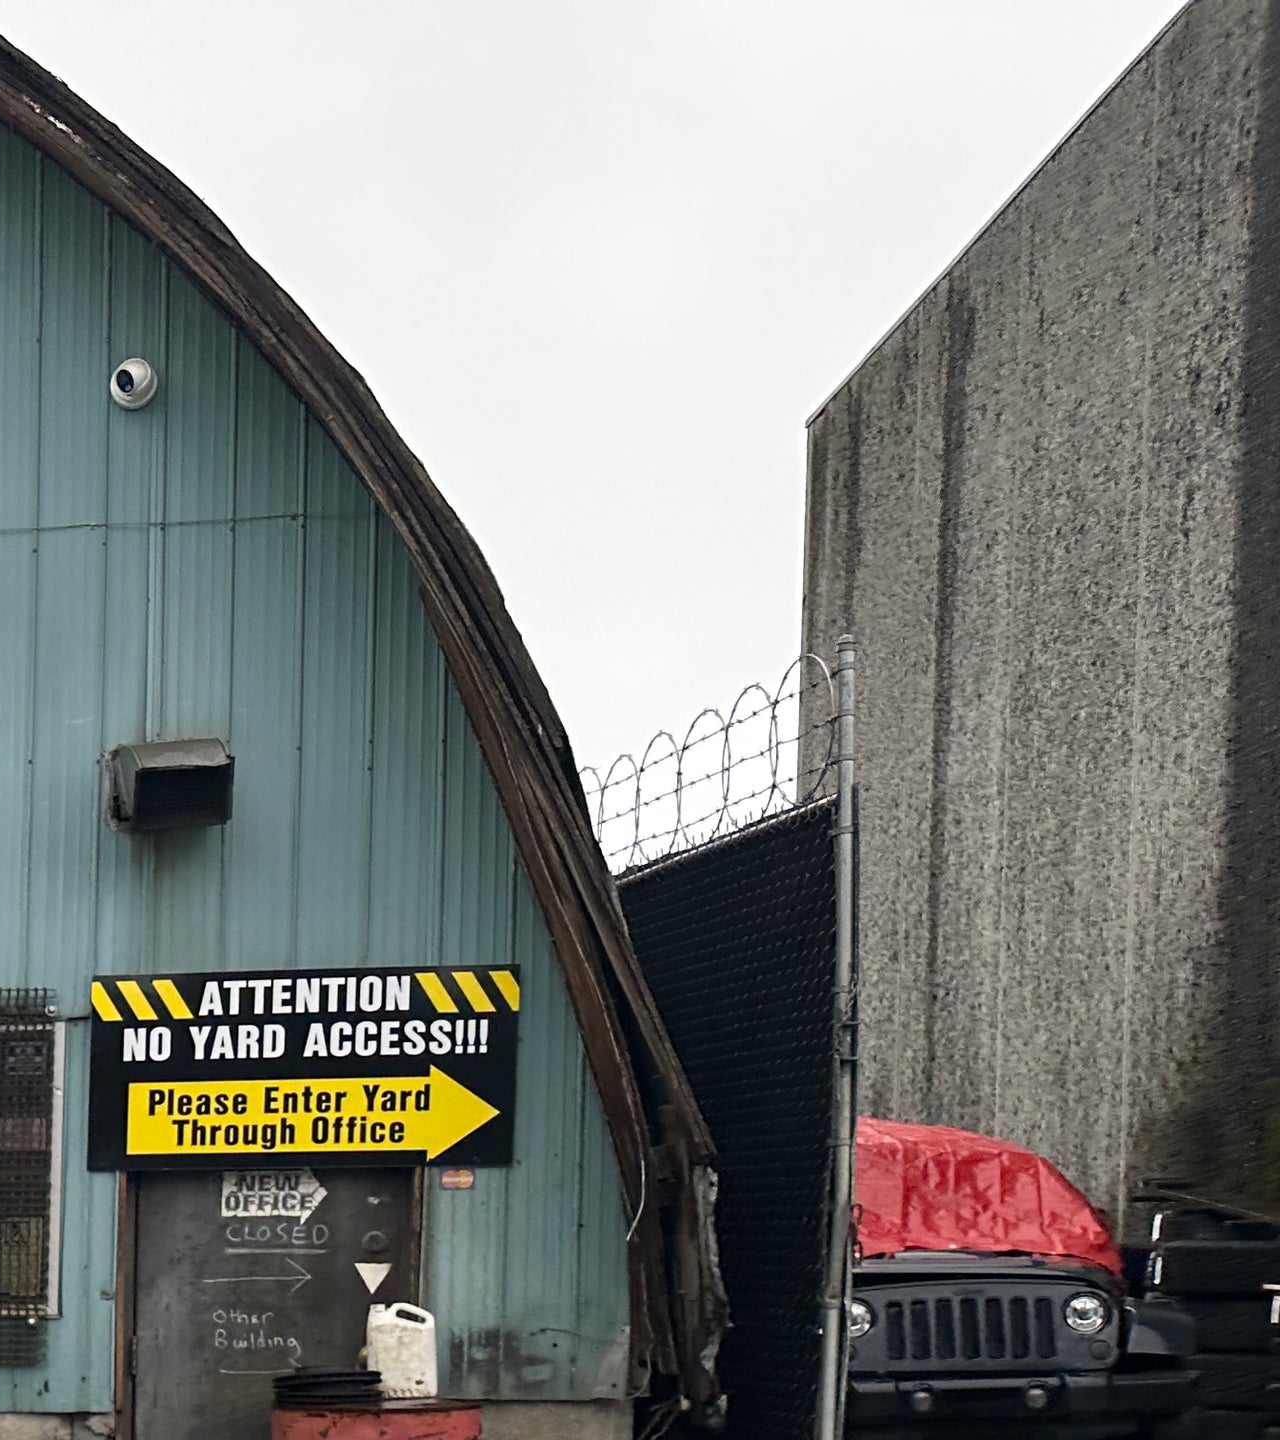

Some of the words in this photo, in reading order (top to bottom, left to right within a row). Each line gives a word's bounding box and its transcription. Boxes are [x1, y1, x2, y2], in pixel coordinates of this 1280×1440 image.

[198, 975, 412, 1017] ATTENTION
[122, 1026, 172, 1062] NO
[188, 1023, 286, 1061] YARD
[303, 1018, 489, 1058] ACCESS!!!
[148, 1087, 248, 1116] Please
[263, 1086, 348, 1114] Enter
[362, 1083, 431, 1113] Yard
[172, 1117, 296, 1150] Through
[311, 1115, 405, 1144] Office
[241, 1174, 300, 1191] NEW
[224, 1191, 314, 1212] OFFICE
[214, 1328, 302, 1361] Building
